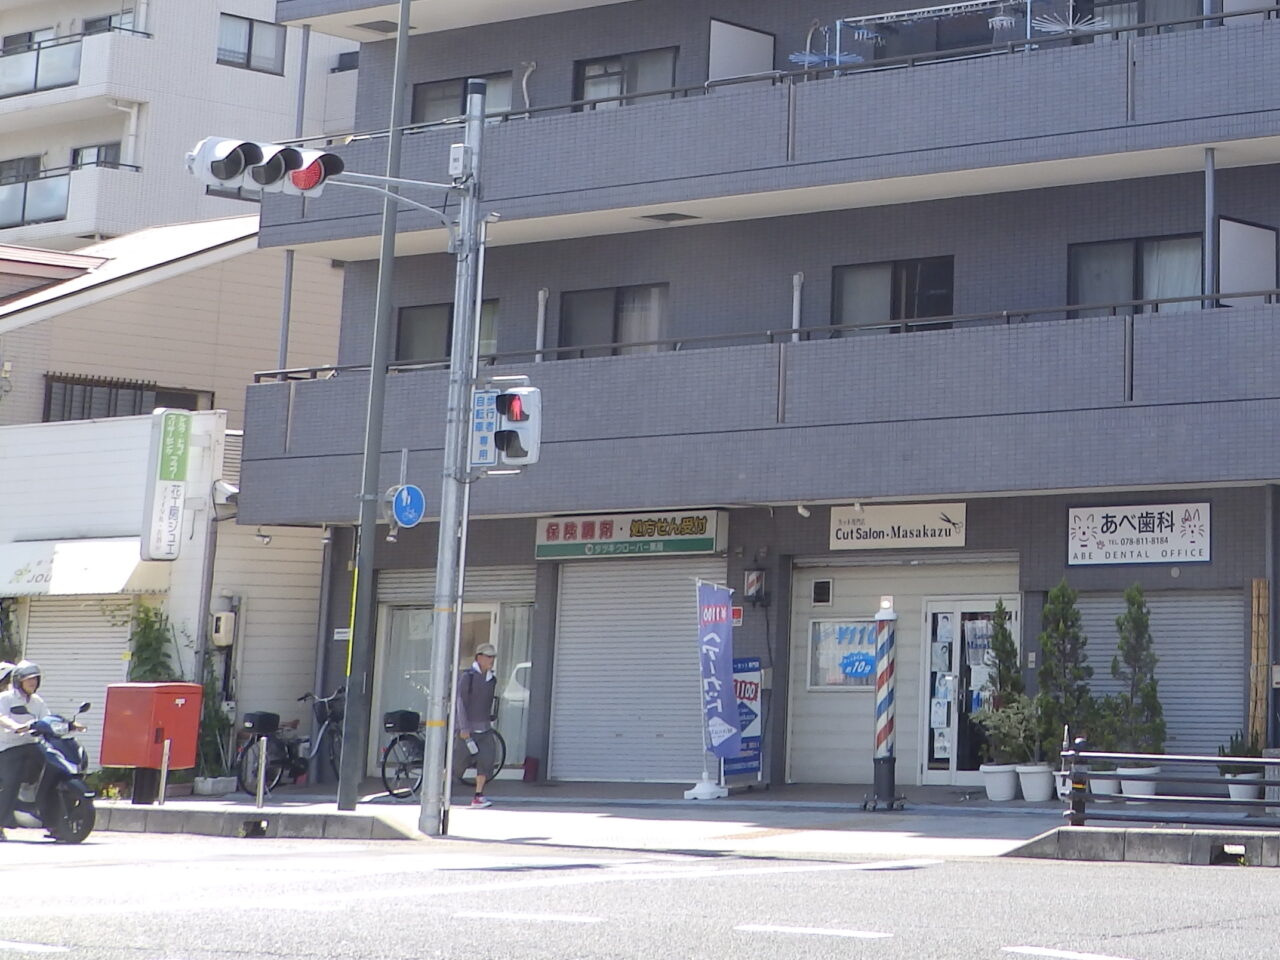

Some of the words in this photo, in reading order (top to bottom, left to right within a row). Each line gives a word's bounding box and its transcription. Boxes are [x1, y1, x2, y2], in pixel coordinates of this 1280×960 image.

[1101, 510, 1175, 534] あべ歯科
[1073, 551, 1094, 560] ABE
[1105, 551, 1150, 560] DENTAL
[1161, 548, 1204, 558] OFFICE
